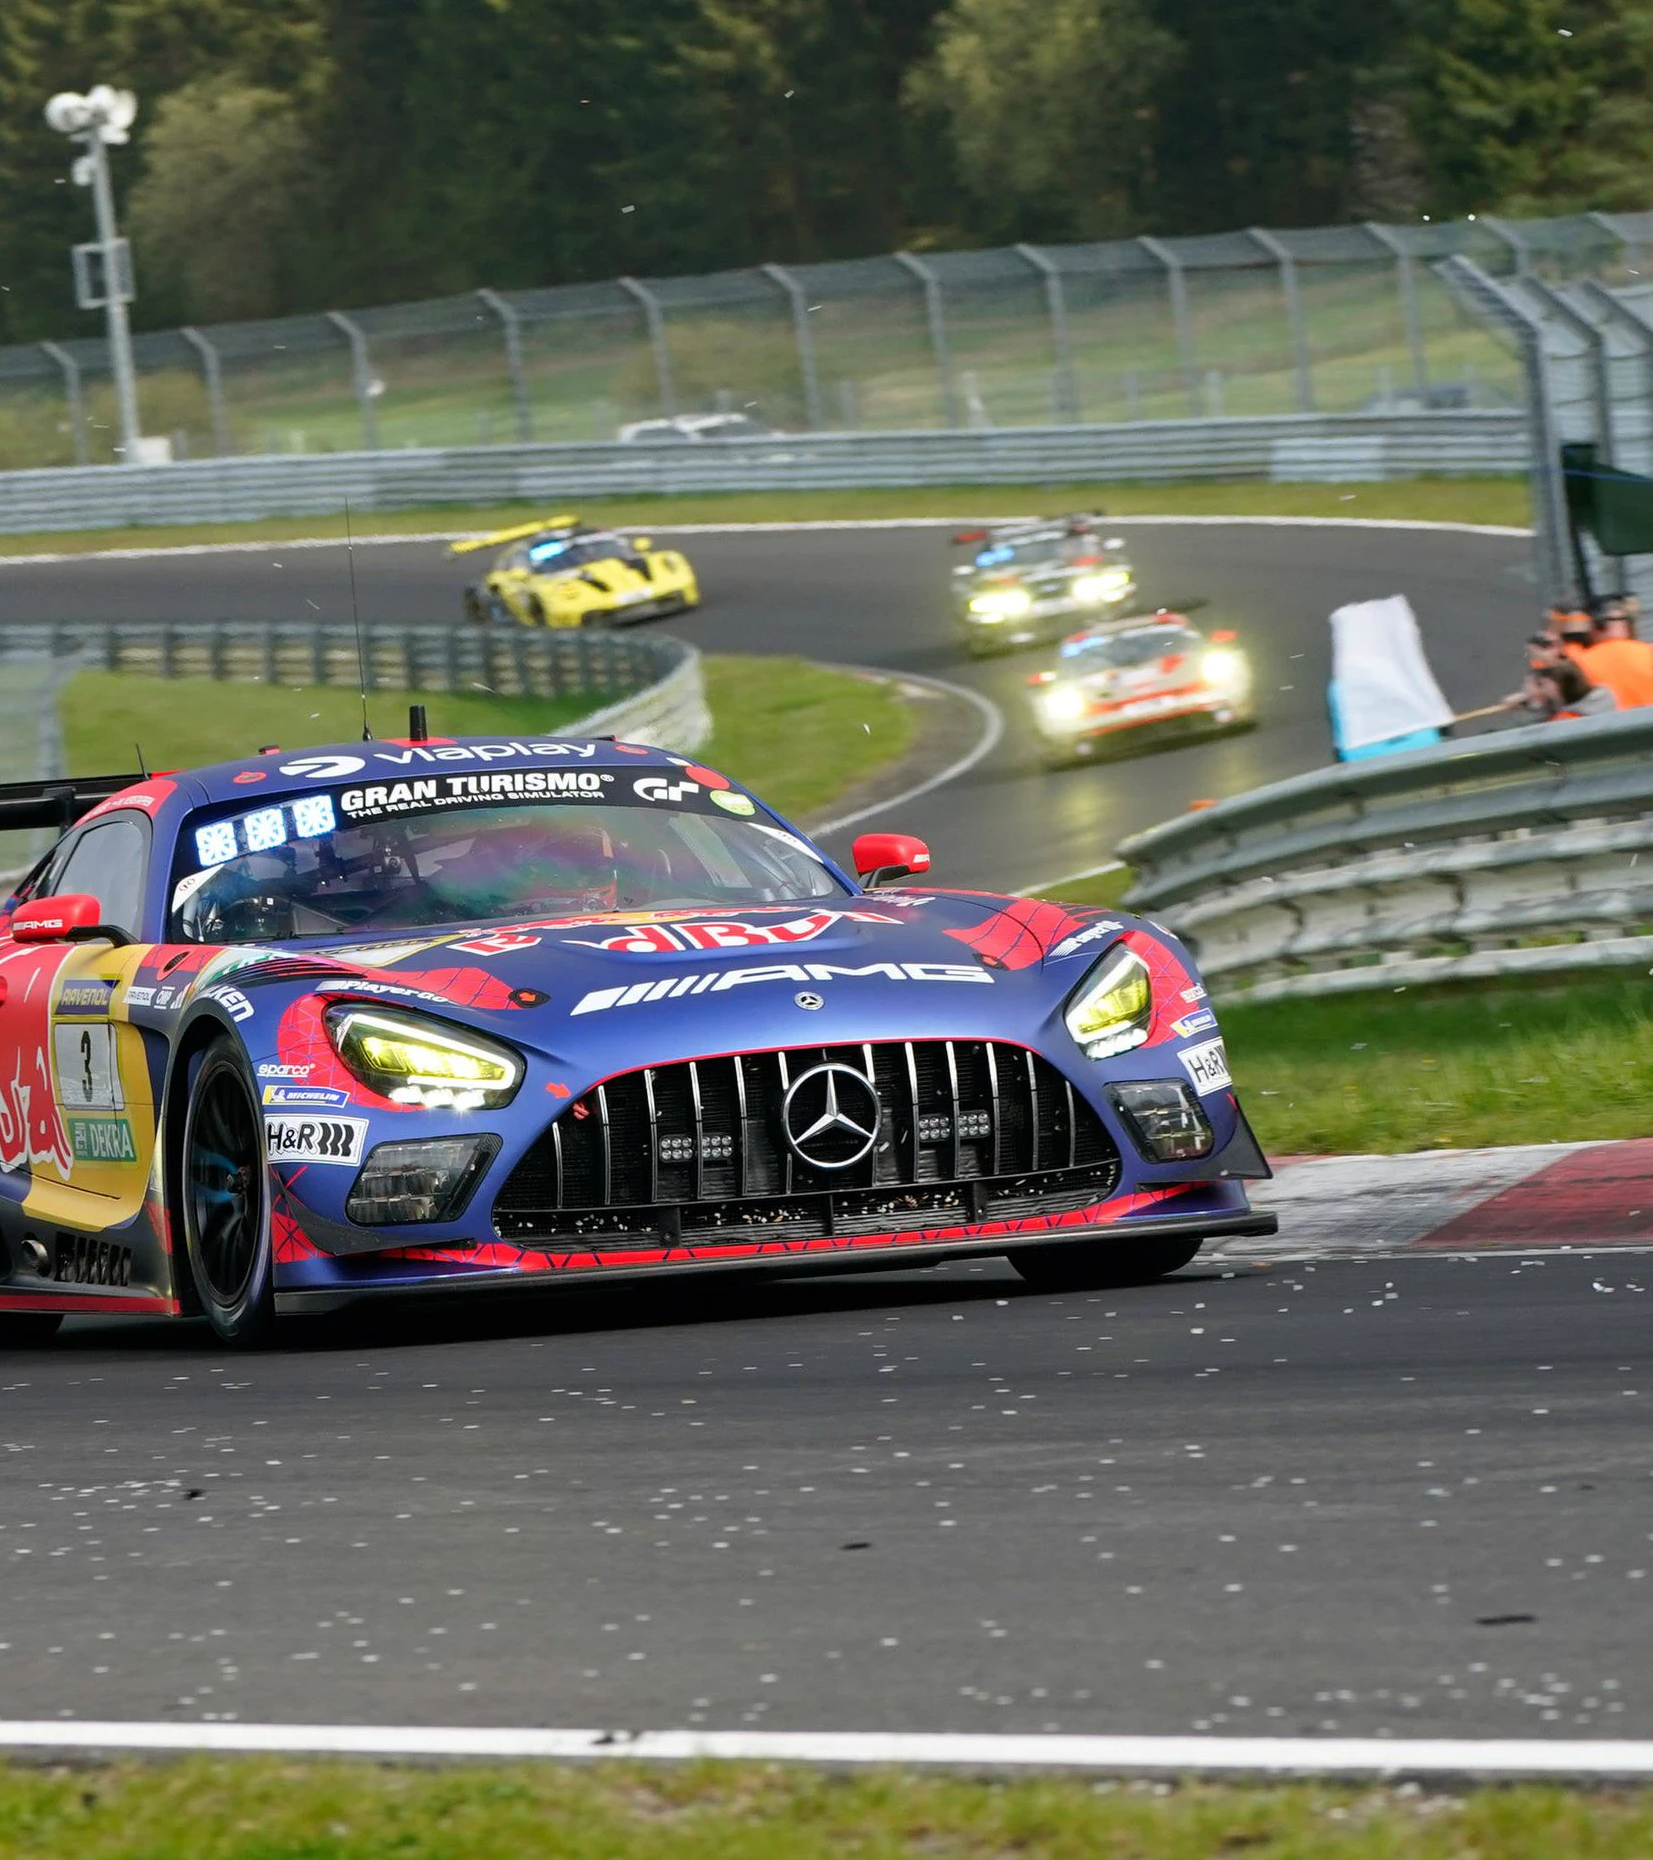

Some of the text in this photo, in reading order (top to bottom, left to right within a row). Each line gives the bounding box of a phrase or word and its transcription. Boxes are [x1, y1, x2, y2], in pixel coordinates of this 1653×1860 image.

[373, 742, 596, 764] viaplay
[341, 779, 437, 811] GRAN
[347, 790, 605, 819] THE REAL DRIVING SIMULATOR
[710, 963, 995, 992] AMG
[61, 988, 108, 1006] RAVENOL
[80, 1030, 93, 1102] 3
[258, 1063, 310, 1077] sparco
[286, 1091, 340, 1101] MICHELIN
[88, 1123, 134, 1158] DEKRA
[267, 1122, 314, 1150] H&R
